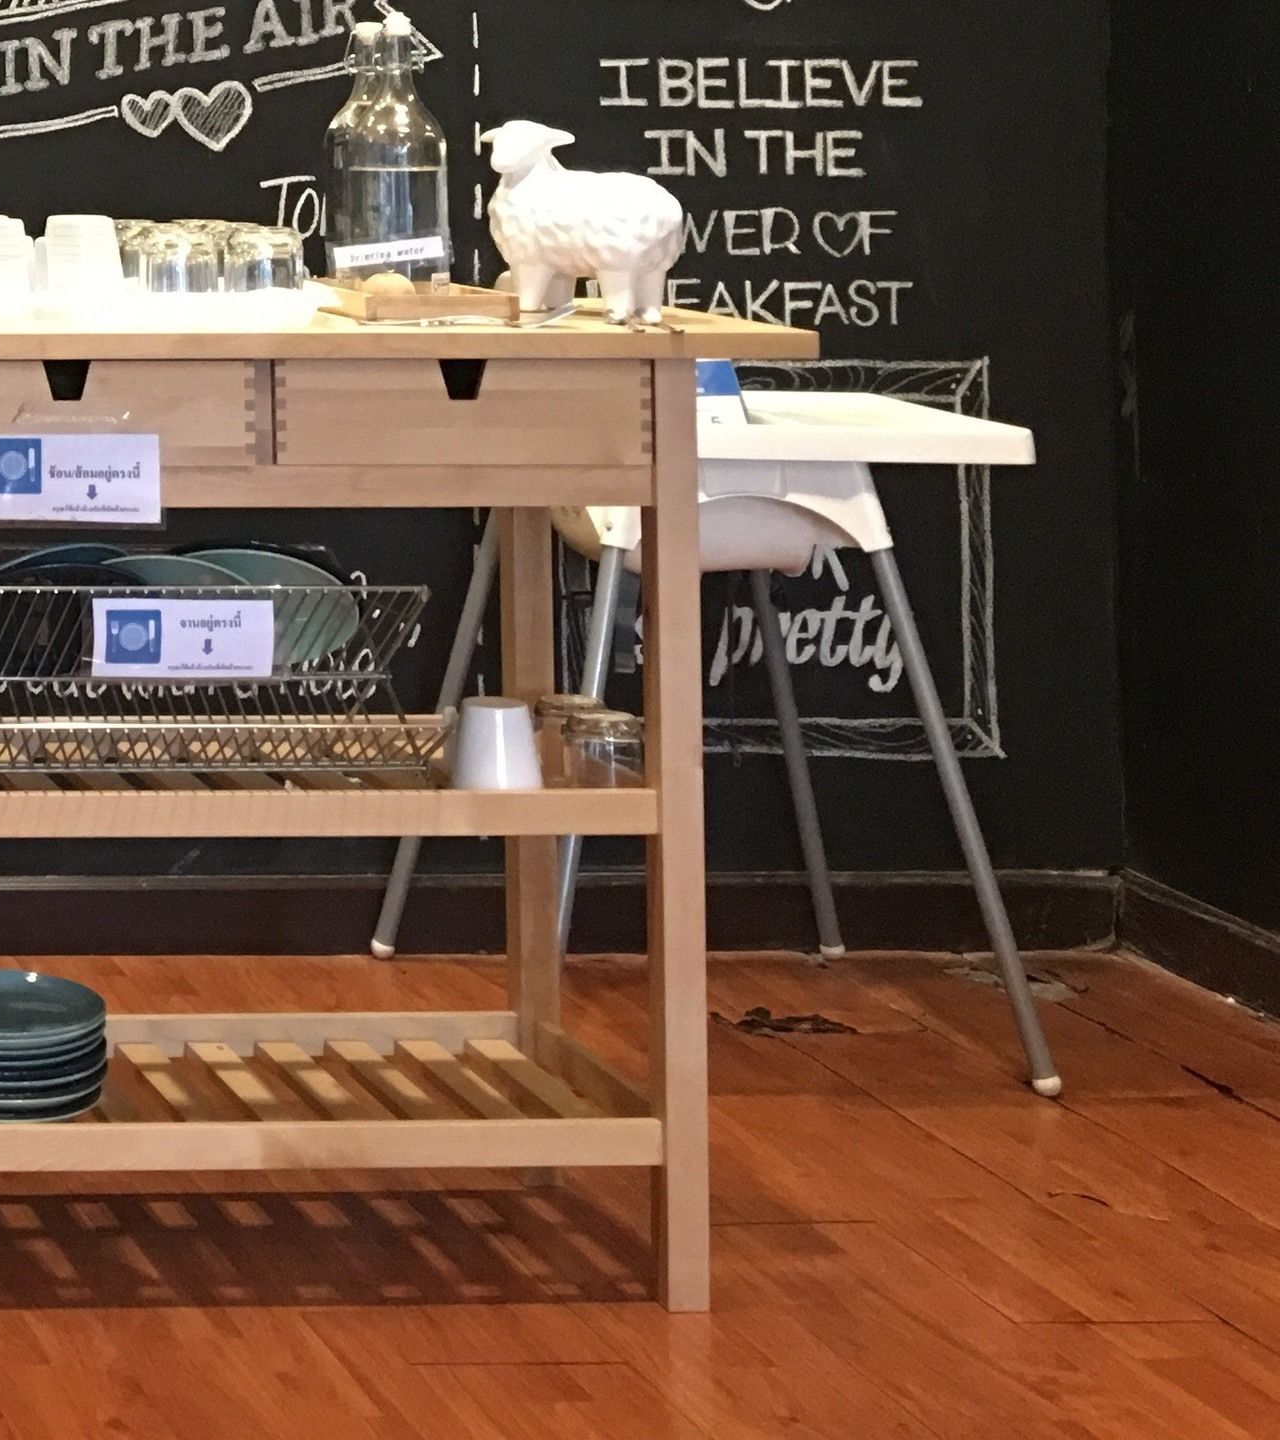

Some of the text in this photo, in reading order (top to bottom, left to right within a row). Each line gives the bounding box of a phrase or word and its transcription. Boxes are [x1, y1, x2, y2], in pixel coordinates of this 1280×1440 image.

[87, 4, 233, 76] THE
[599, 56, 923, 108] I BELIEVE
[644, 129, 867, 177] IN THE
